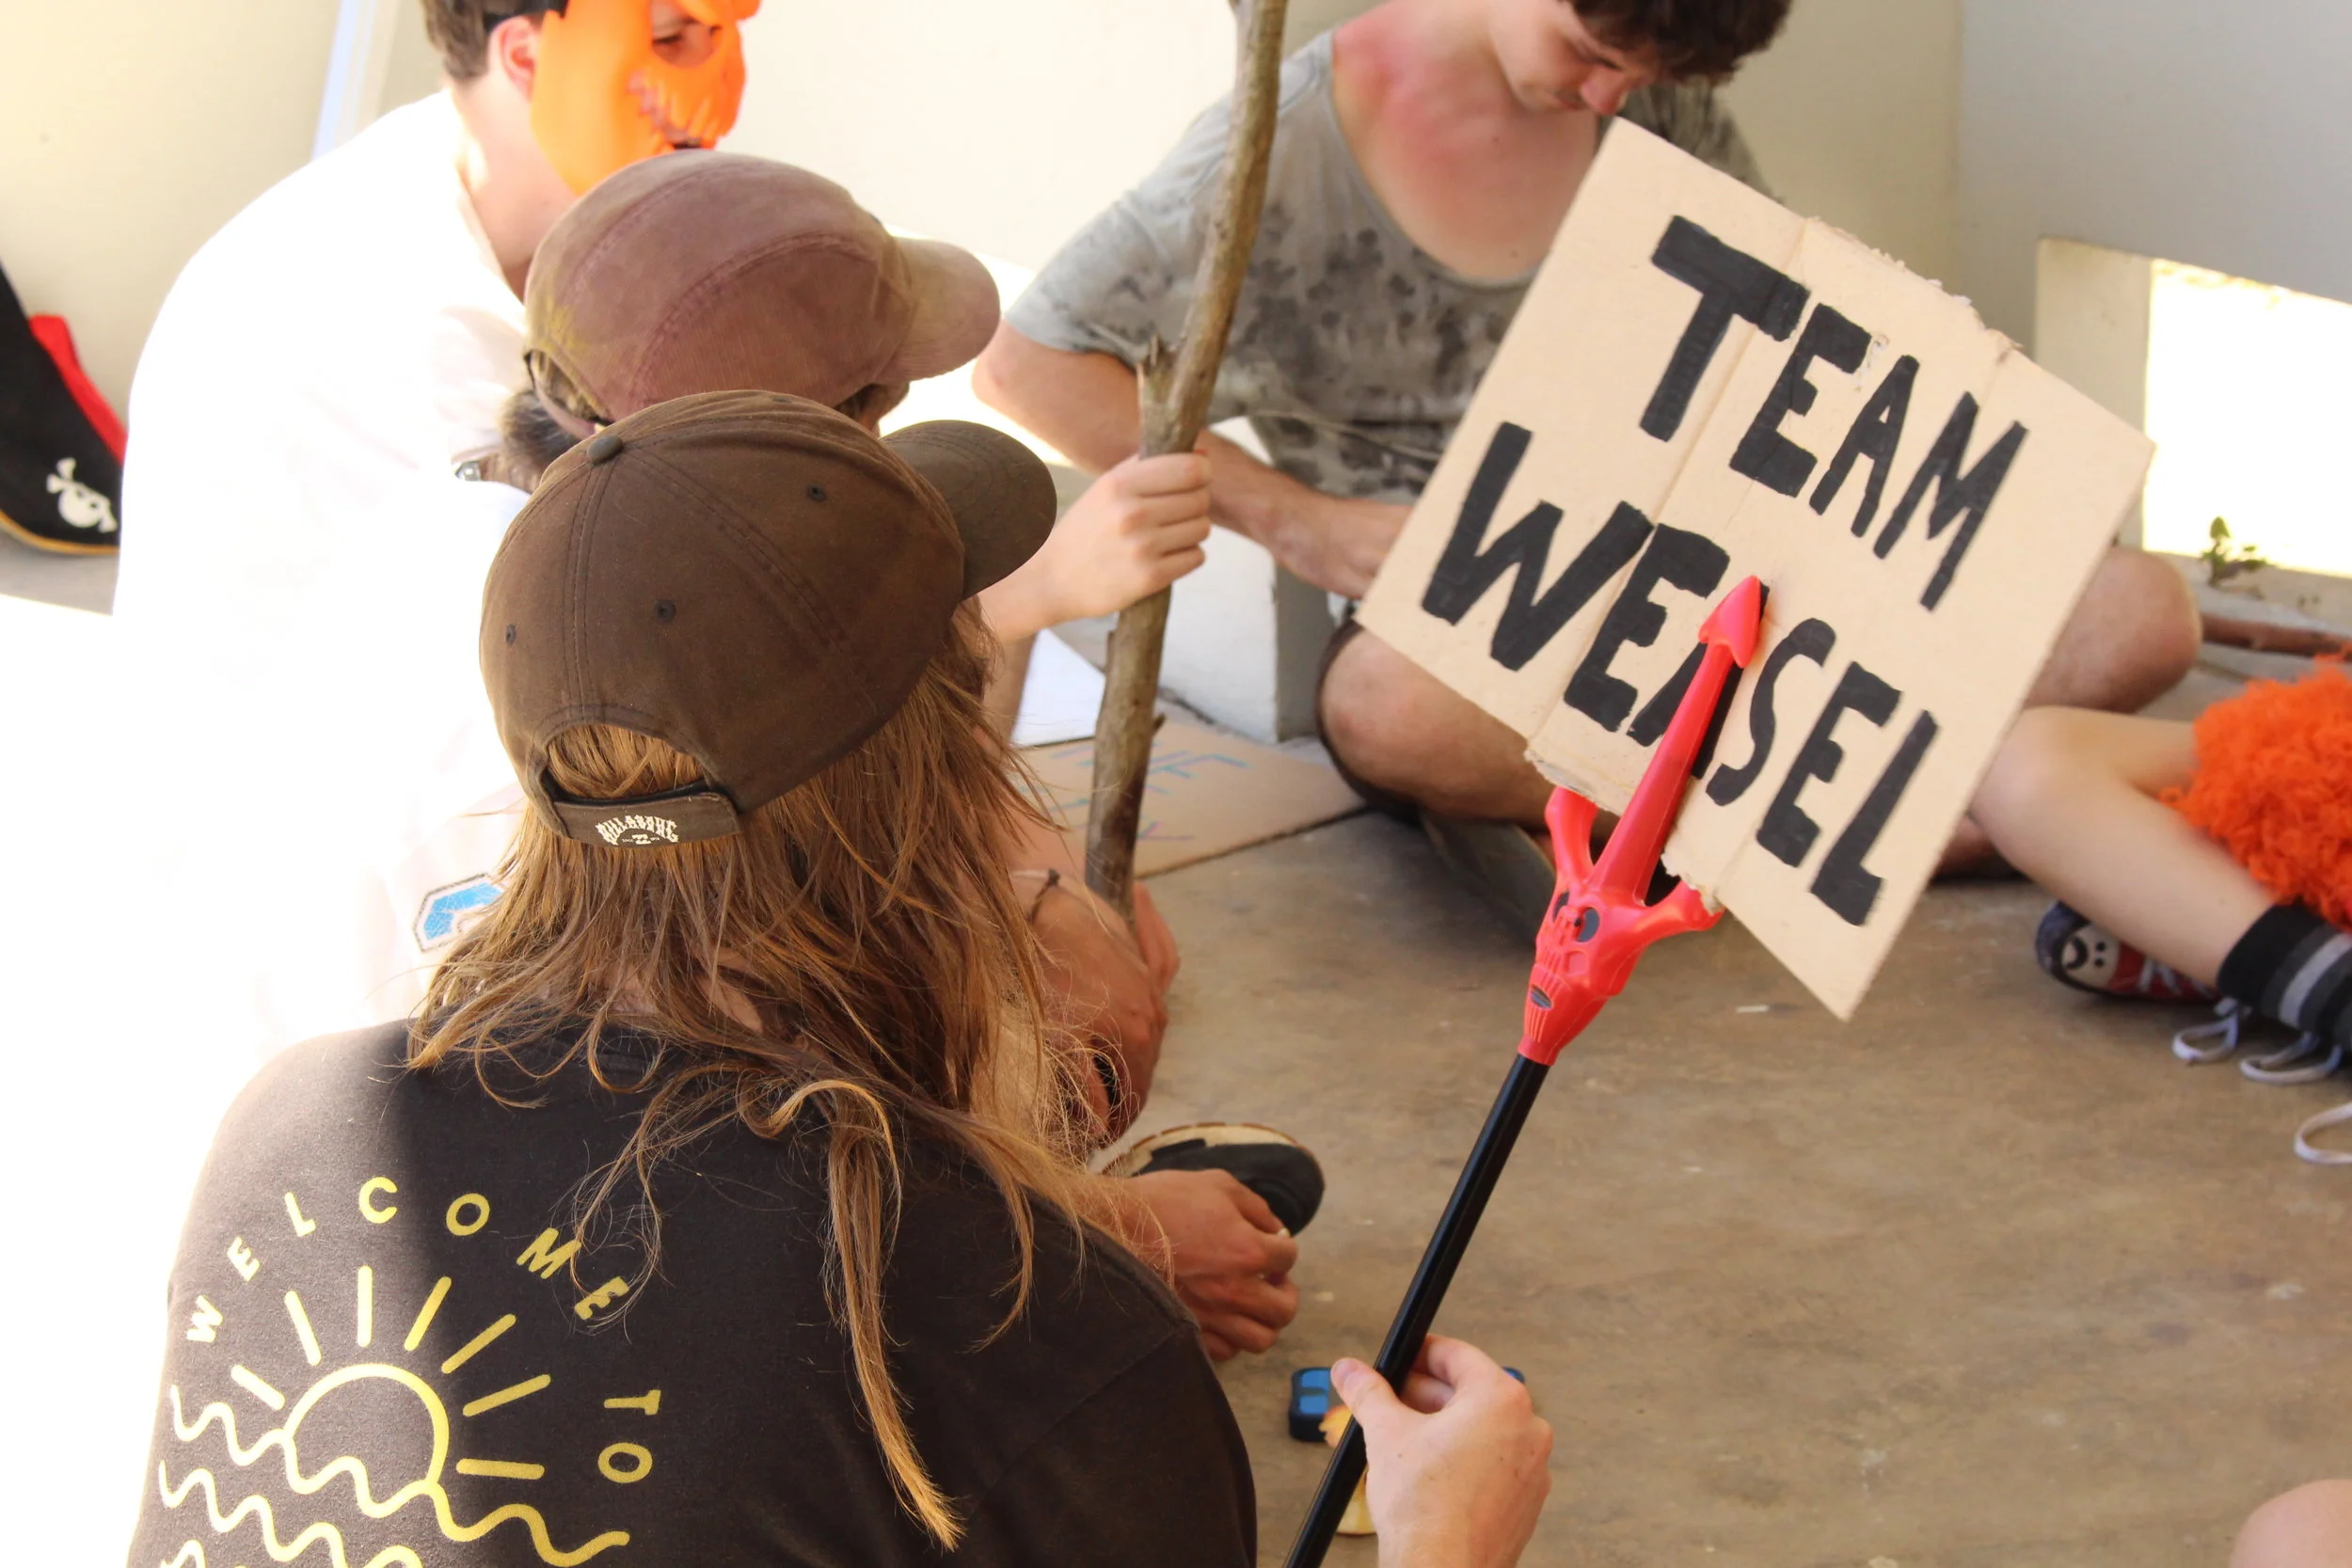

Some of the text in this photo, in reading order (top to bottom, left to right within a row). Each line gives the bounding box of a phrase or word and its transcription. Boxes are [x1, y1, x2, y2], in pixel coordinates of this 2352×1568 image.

[1641, 215, 2028, 611] TEAM
[186, 1177, 660, 1483] WELCOME TO
